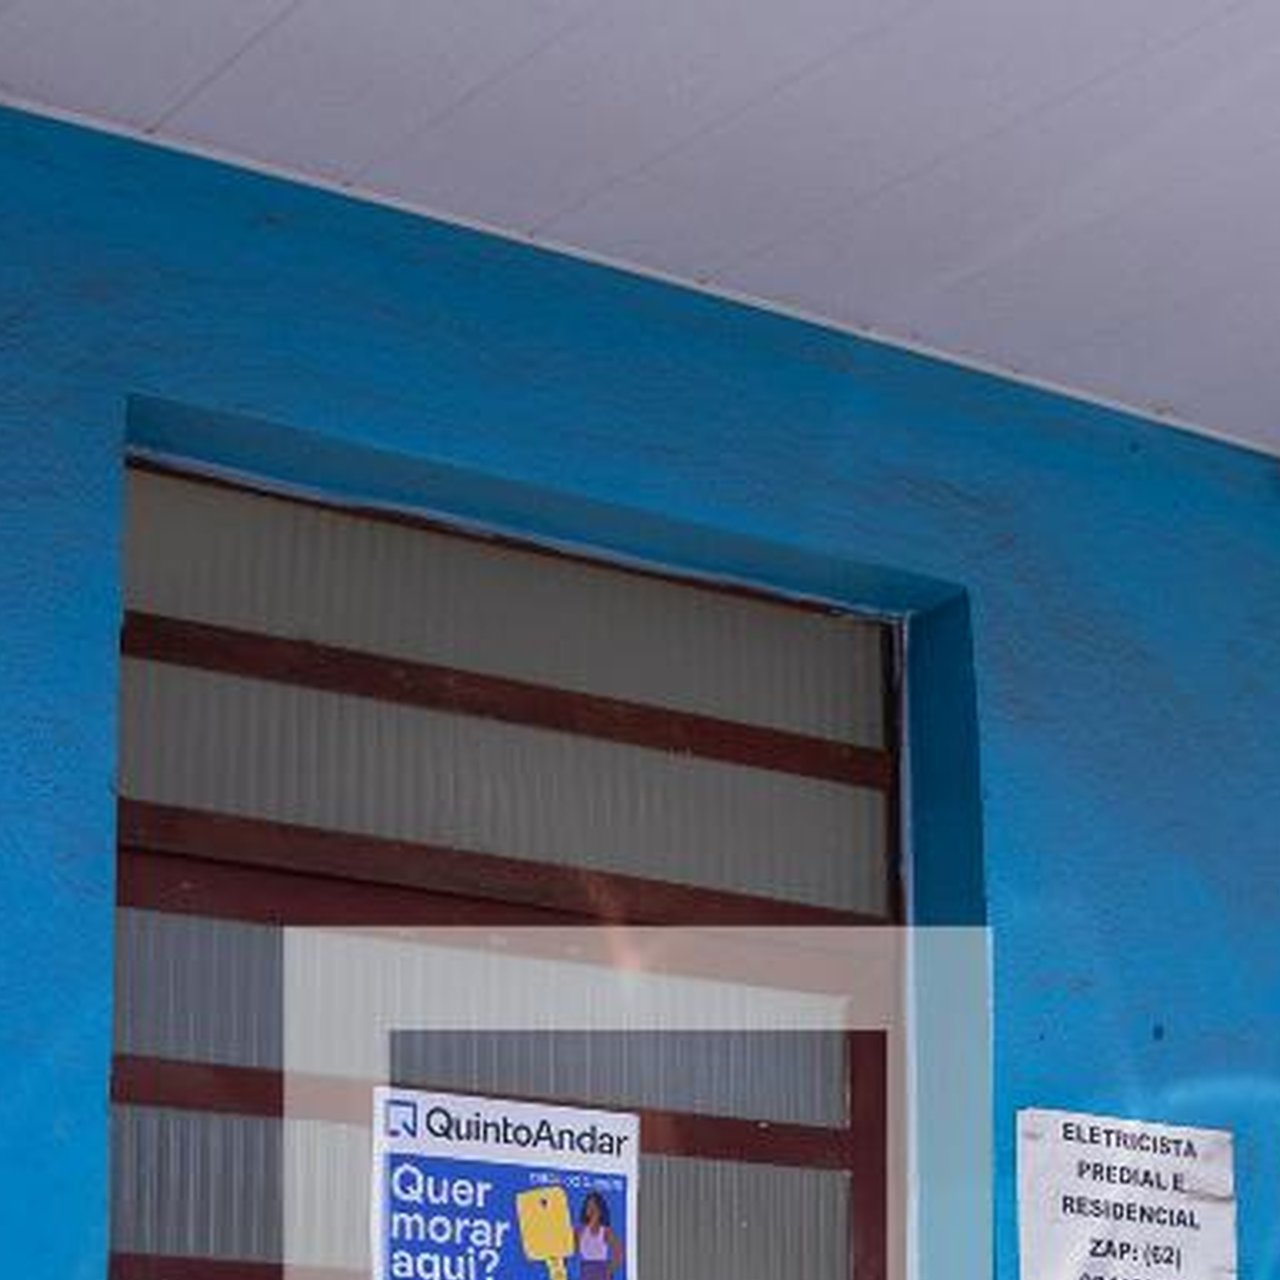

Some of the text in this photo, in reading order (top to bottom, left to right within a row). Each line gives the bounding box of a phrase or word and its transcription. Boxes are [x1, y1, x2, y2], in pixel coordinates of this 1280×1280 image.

[425, 1106, 629, 1157] QuintoAndar
[1062, 1122, 1198, 1158] ELETRICISTA
[391, 1163, 492, 1207] Quer
[1078, 1161, 1185, 1193] PREDIAL E
[391, 1212, 511, 1247] morar
[1062, 1196, 1200, 1230] RESIDENCIAL
[1089, 1239, 1138, 1262] ZAP:
